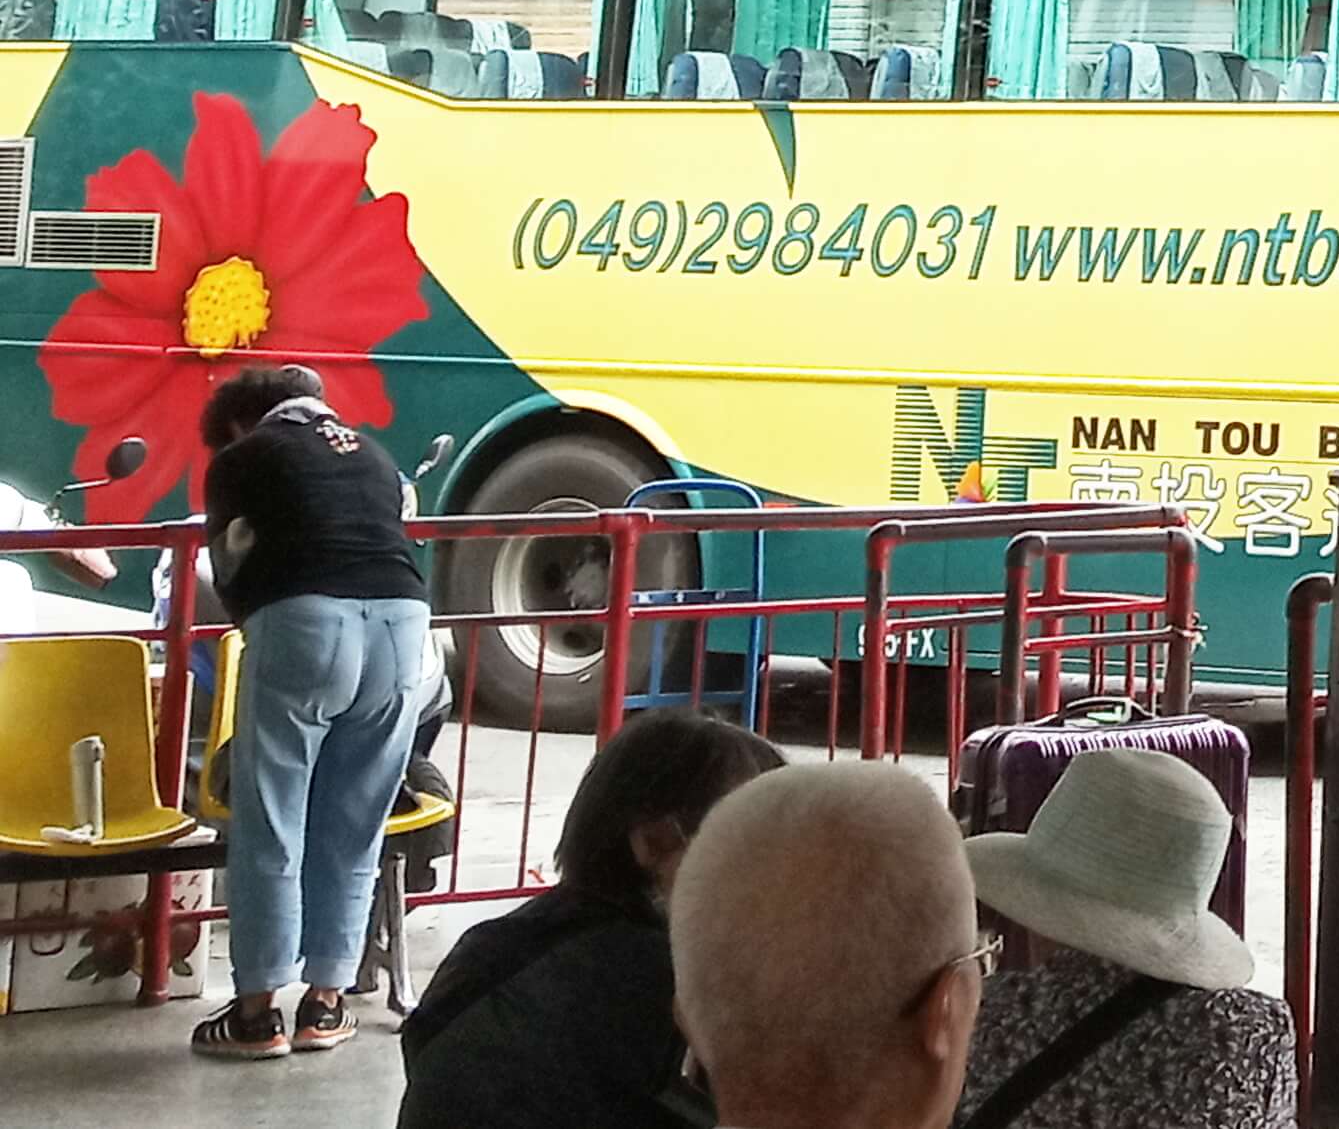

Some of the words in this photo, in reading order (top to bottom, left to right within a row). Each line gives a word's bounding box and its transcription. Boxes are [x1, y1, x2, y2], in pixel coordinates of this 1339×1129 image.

[512, 198, 999, 282] (049)2984031
[1072, 416, 1157, 452] NAN
[1196, 421, 1281, 456] TOU
